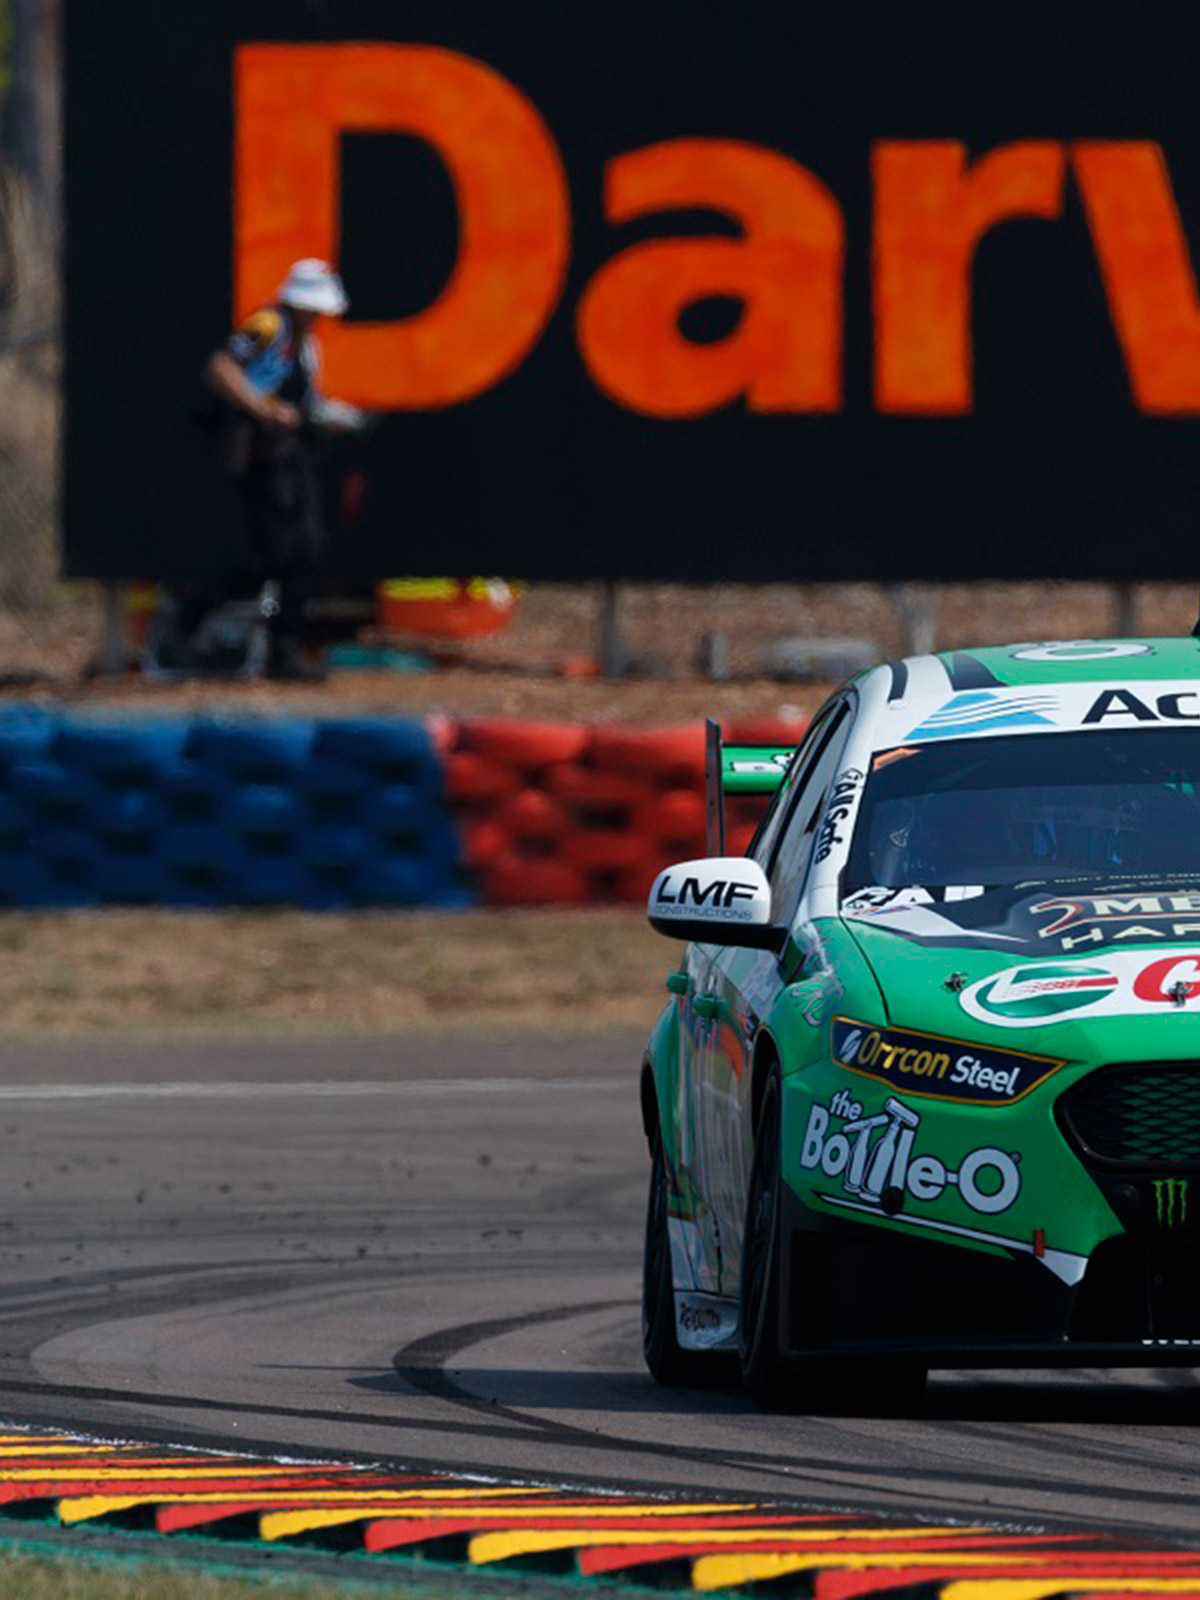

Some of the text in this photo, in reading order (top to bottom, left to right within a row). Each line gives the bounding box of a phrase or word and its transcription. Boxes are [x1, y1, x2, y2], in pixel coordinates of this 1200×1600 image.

[656, 875, 759, 908] LMF
[857, 1031, 1021, 1096] Orrcon Steel
[829, 1089, 862, 1121] the
